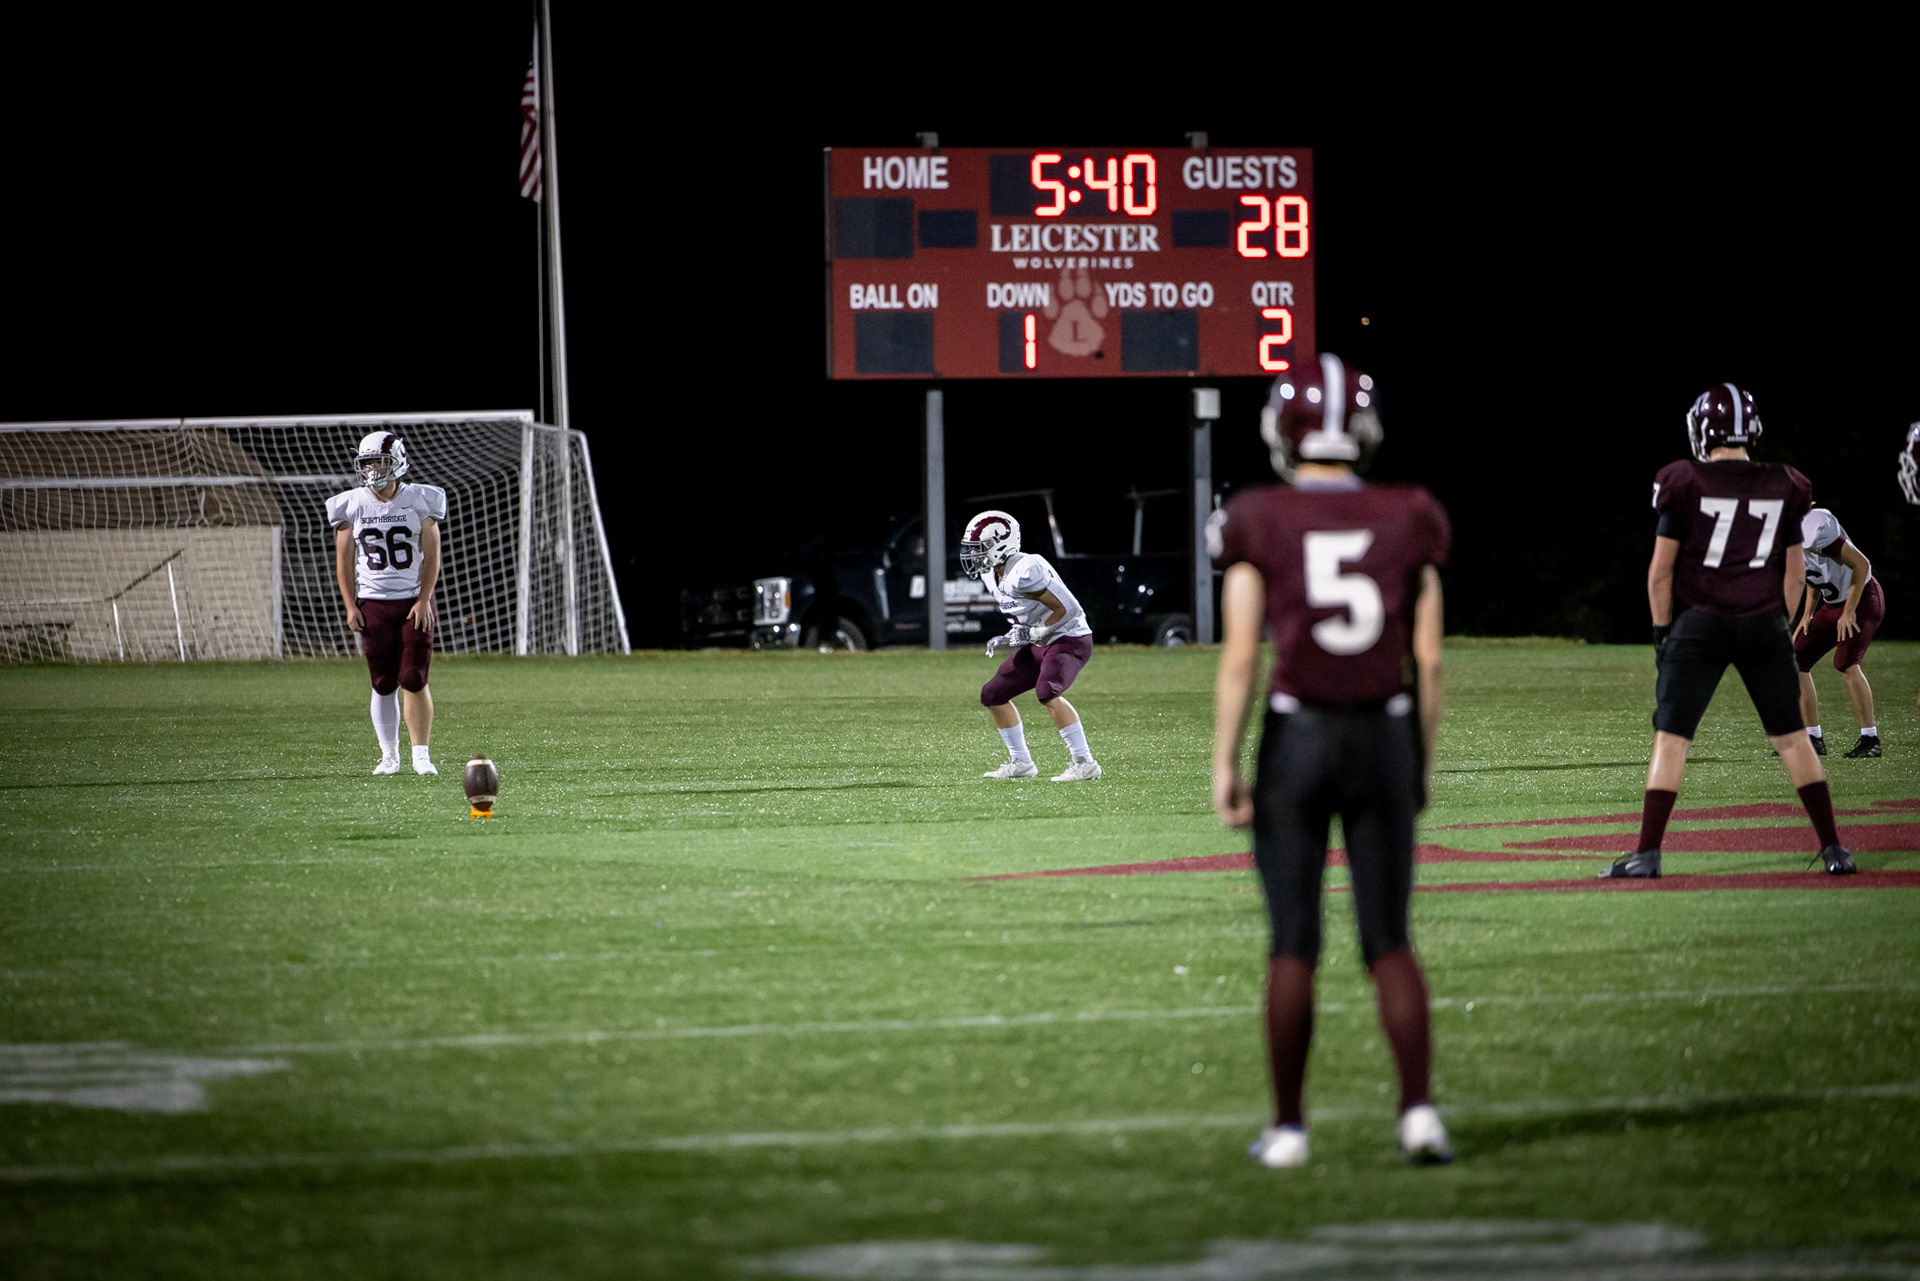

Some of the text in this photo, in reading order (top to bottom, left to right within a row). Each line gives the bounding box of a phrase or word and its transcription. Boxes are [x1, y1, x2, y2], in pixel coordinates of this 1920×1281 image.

[863, 156, 949, 190] HOME
[1031, 153, 1157, 217] 5:40
[1183, 156, 1297, 190] GUESTS
[991, 224, 1160, 252] LEICESTER
[1237, 195, 1309, 258] 28
[1013, 256, 1134, 270] WOLVERINES
[849, 283, 938, 310] BALL ON
[986, 282, 1050, 308] DOWN
[1105, 282, 1214, 308] YDS TO GO
[1251, 281, 1294, 307] QTR
[1024, 313, 1037, 370] 1
[1071, 321, 1087, 342] L
[1258, 308, 1292, 371] 2
[361, 514, 407, 525] NORTHBRIDGE
[1699, 496, 1785, 569] 77
[358, 526, 413, 571] 66
[1303, 529, 1385, 655] 5
